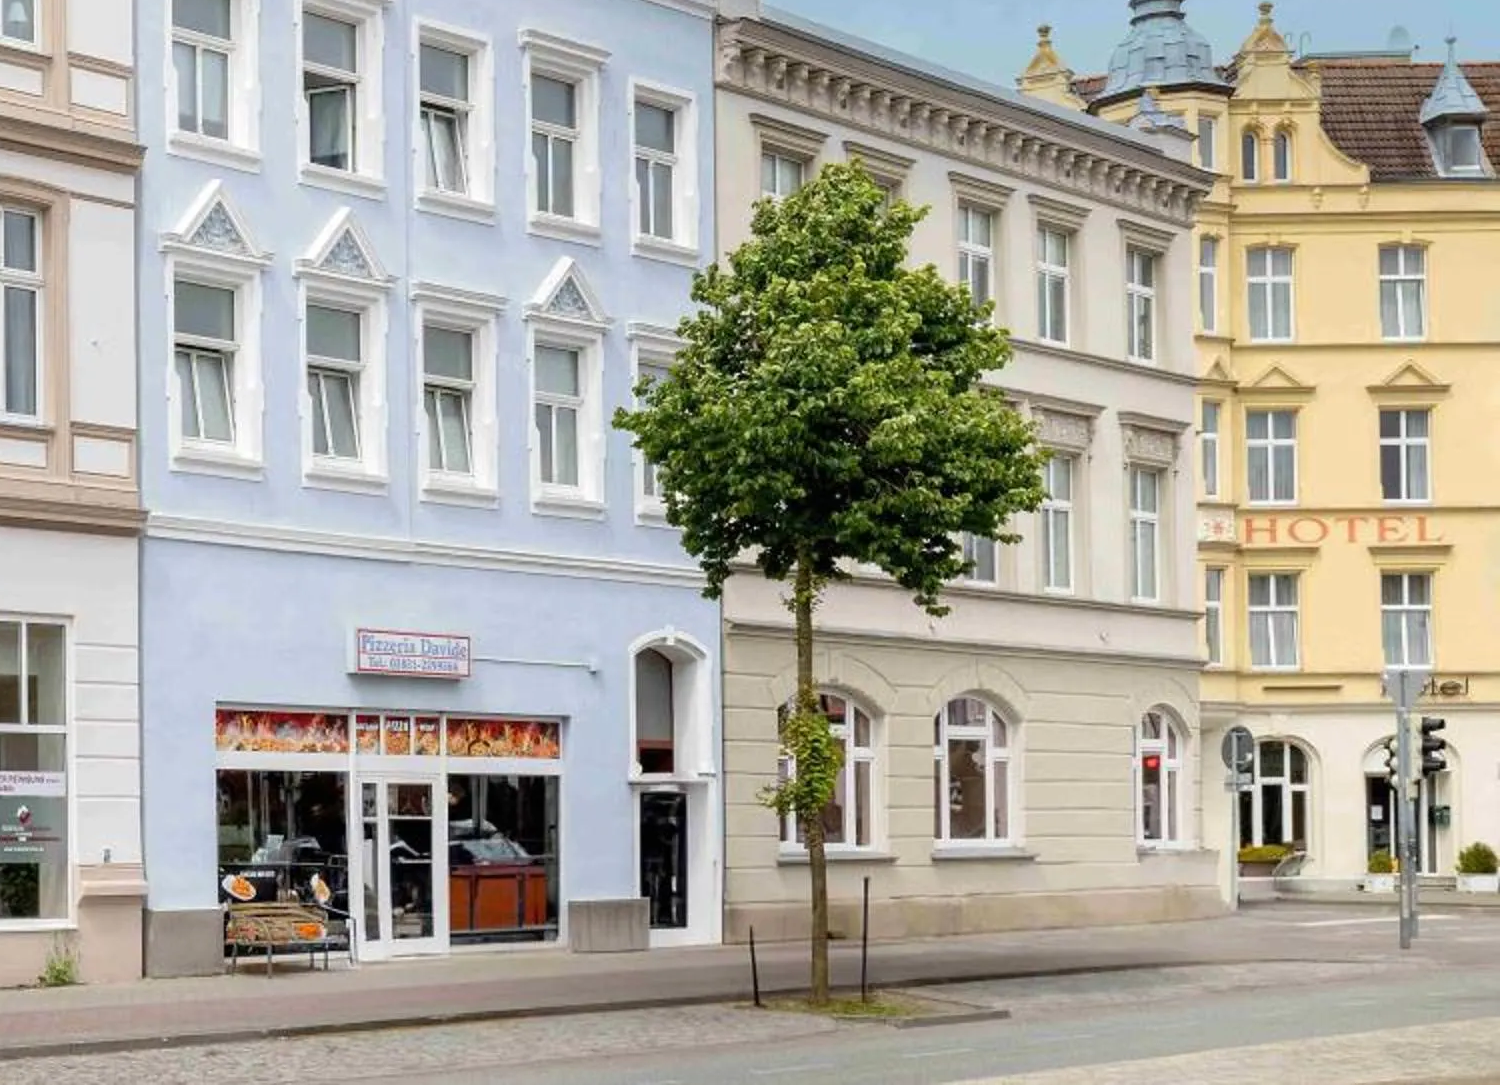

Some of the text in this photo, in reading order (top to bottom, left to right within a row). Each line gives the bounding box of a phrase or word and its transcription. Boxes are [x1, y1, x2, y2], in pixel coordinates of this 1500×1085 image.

[1243, 515, 1444, 544] HOTEL
[361, 634, 467, 658] Pizzeria Davide
